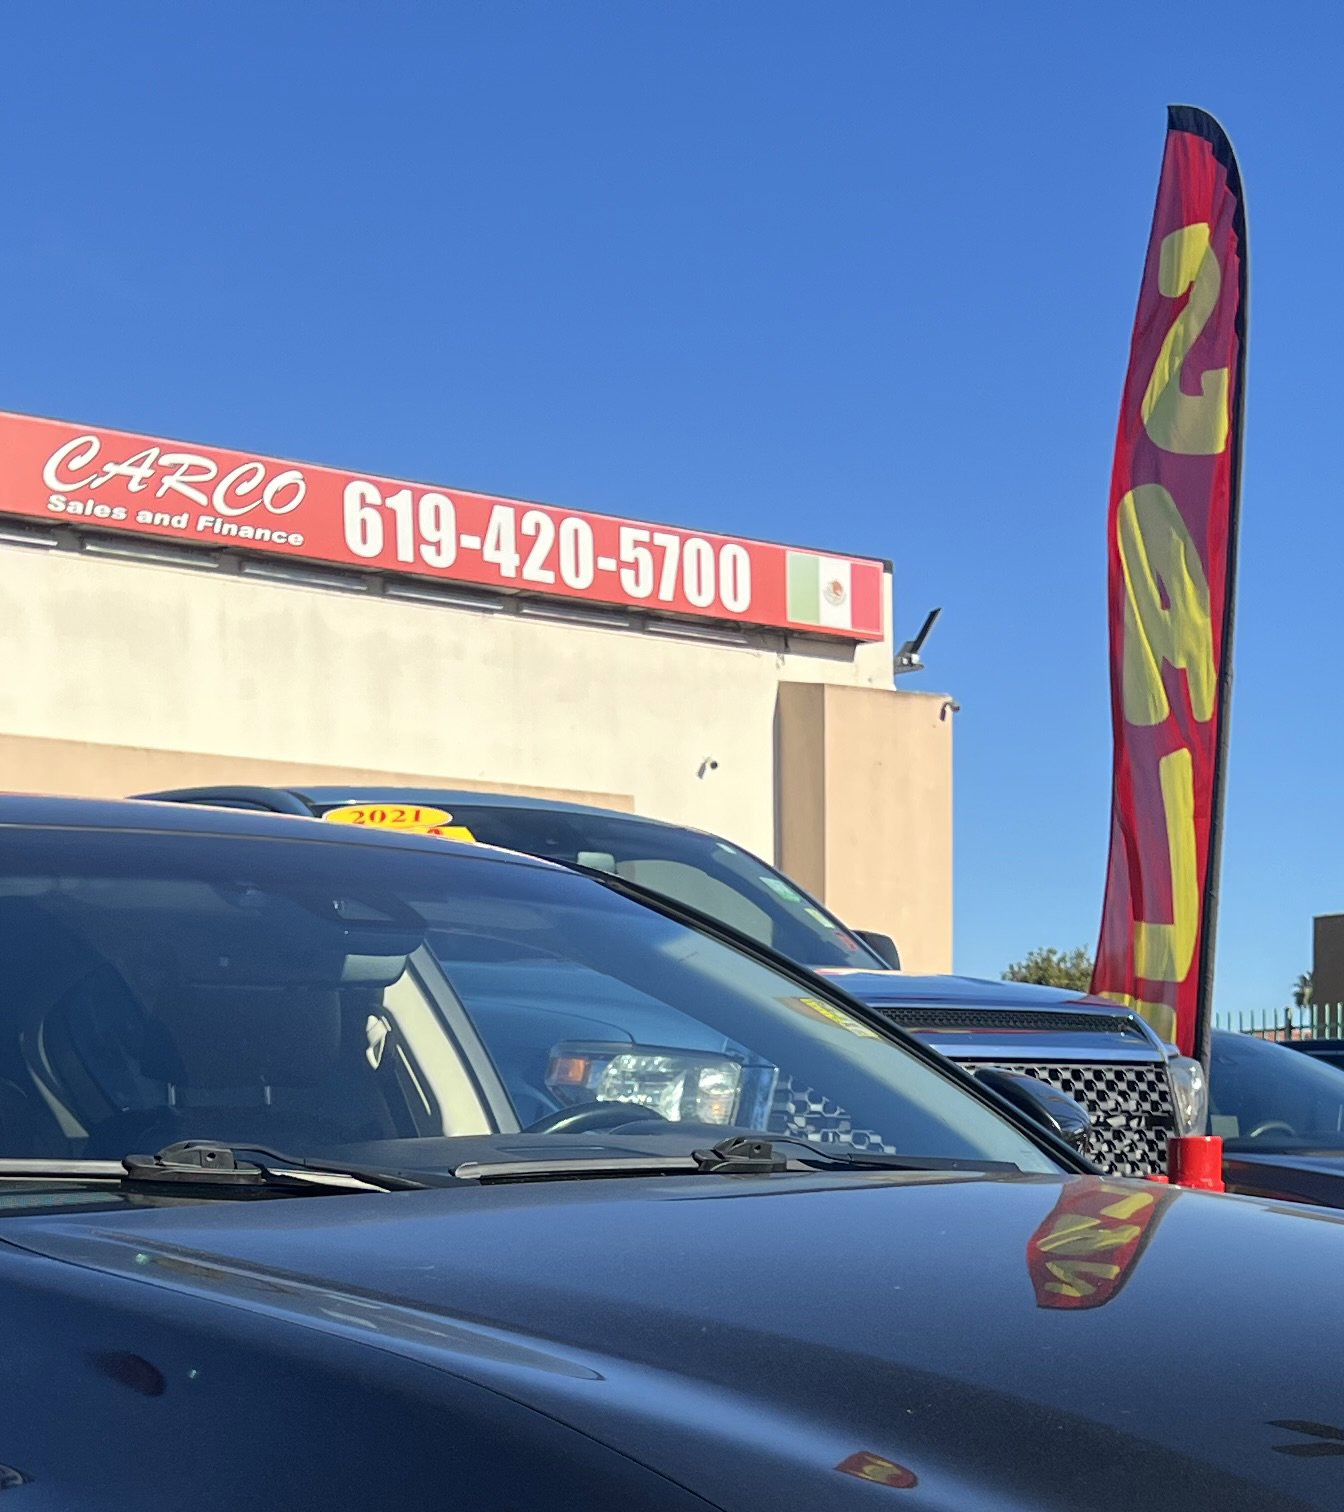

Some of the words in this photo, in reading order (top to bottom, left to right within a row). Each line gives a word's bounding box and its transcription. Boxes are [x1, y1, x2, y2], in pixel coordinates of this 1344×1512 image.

[42, 435, 307, 517] CARCO
[47, 494, 127, 521] Sales
[136, 508, 189, 530] and
[196, 514, 306, 546] Finance
[343, 480, 752, 614] 619-420-5700
[349, 809, 422, 825] 2021
